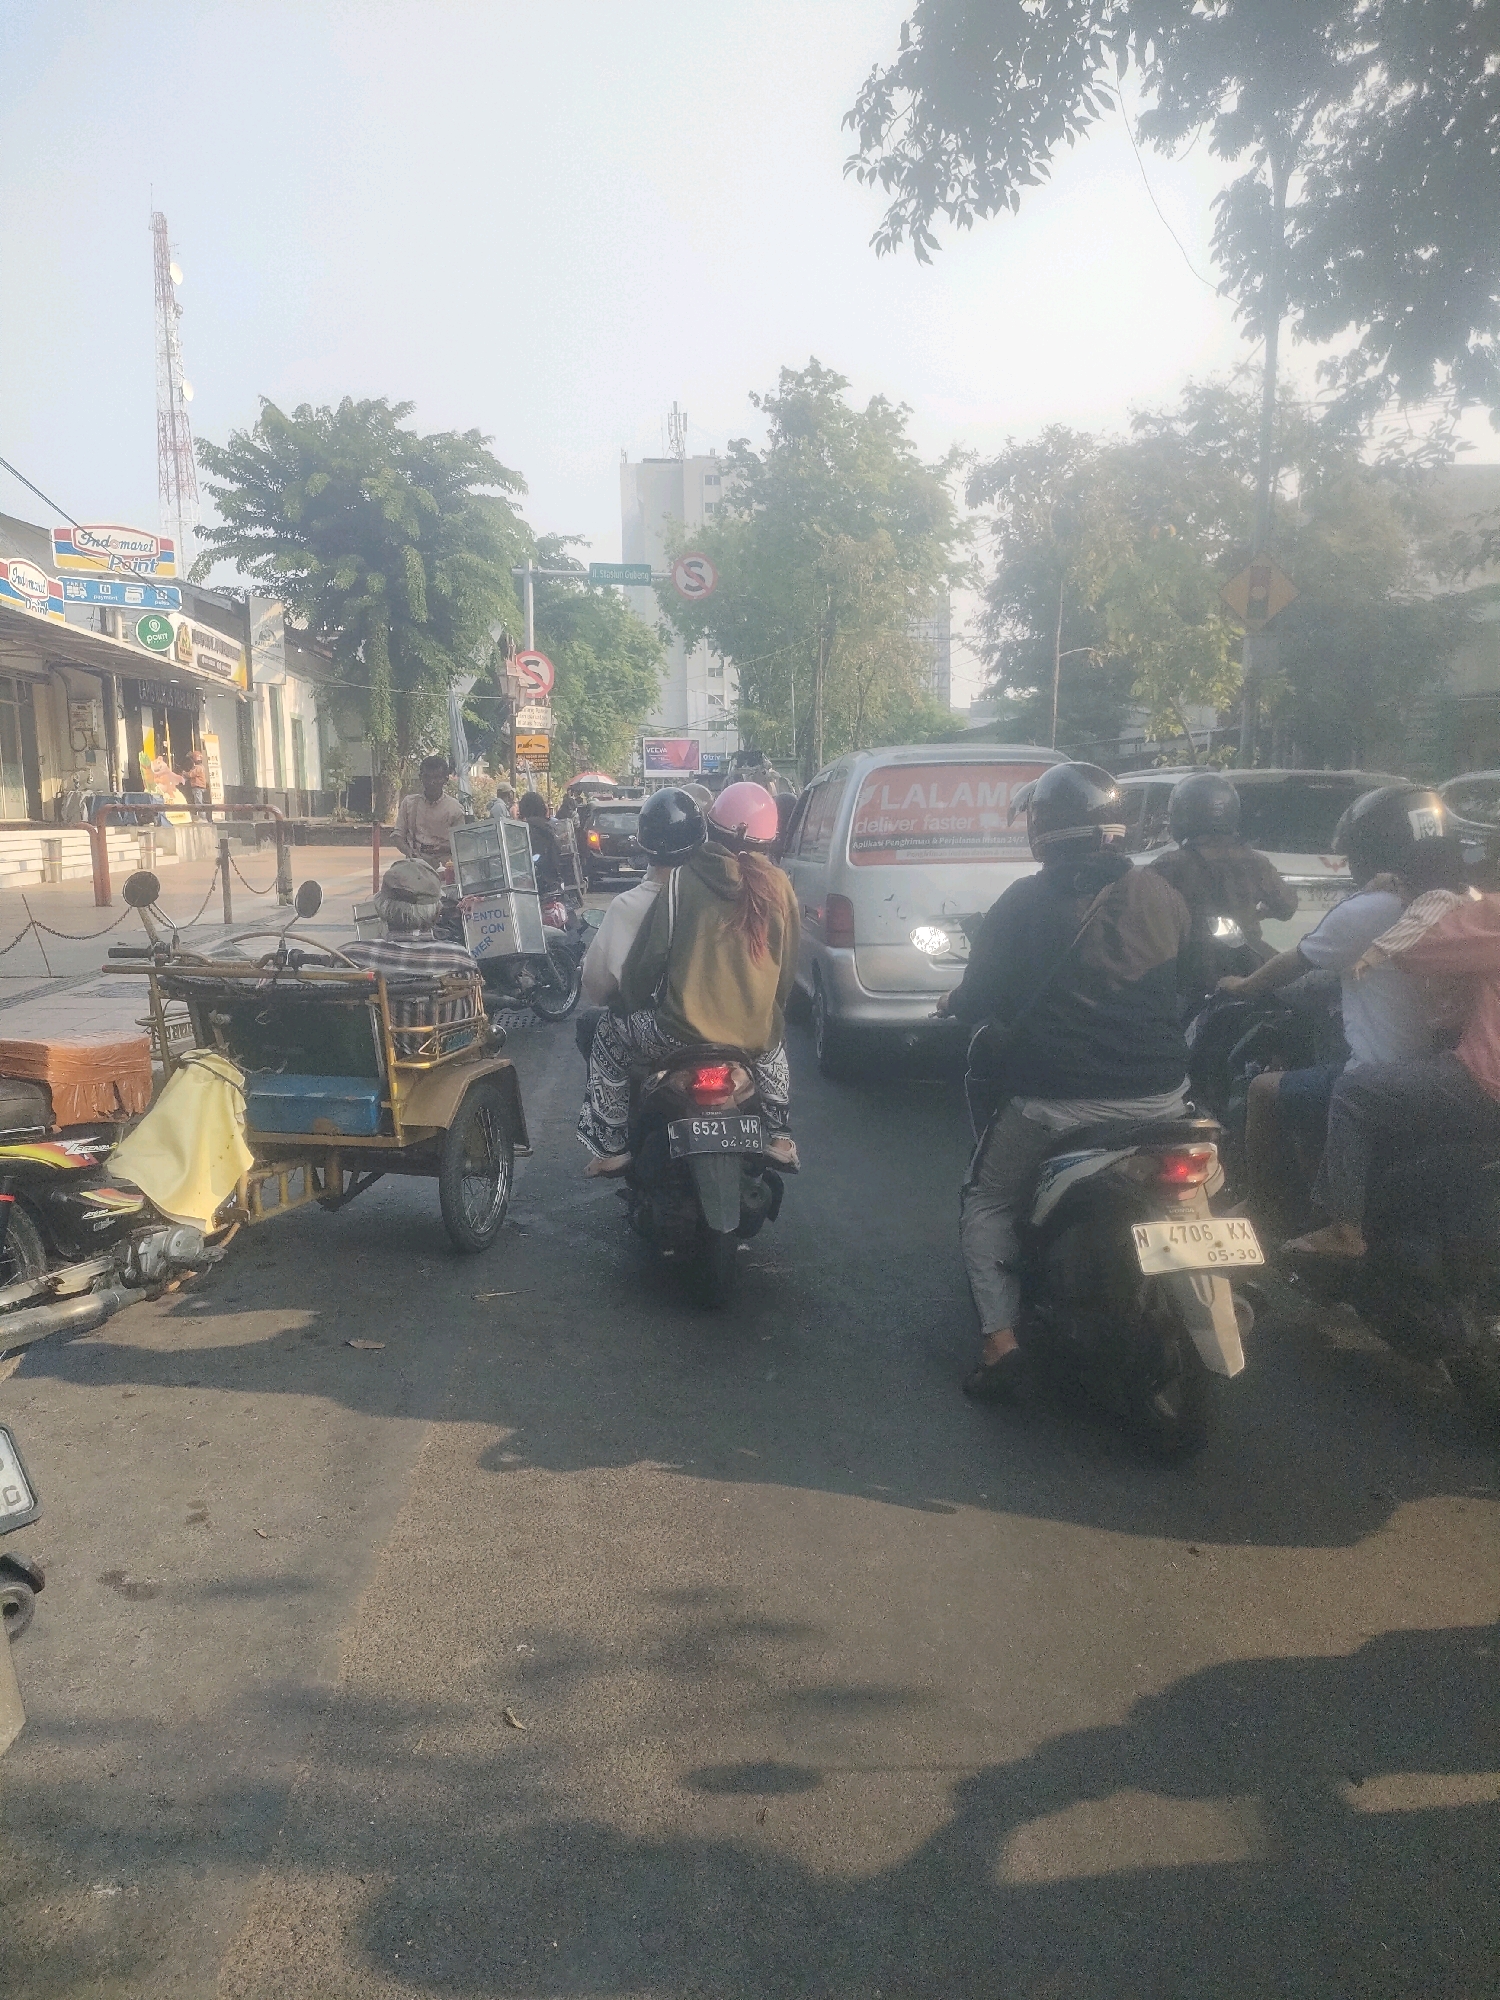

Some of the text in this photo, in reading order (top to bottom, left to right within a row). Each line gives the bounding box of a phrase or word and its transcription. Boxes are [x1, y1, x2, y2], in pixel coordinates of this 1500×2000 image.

[78, 531, 154, 553] Indomaret
[110, 556, 158, 573] Point
[600, 569, 624, 579] Stasiun
[624, 570, 649, 582] Gubeng
[854, 814, 975, 834] deliver faster
[852, 840, 884, 850] Aplikasi
[885, 838, 930, 847] Pengiriman
[1007, 836, 1025, 845] 24/7
[465, 909, 510, 923] PENTOL
[481, 922, 505, 935] CON
[471, 936, 494, 958] MER
[692, 1120, 727, 1136] 6521
[740, 1119, 758, 1134] WR
[1136, 1222, 1251, 1248] N 4706 KX
